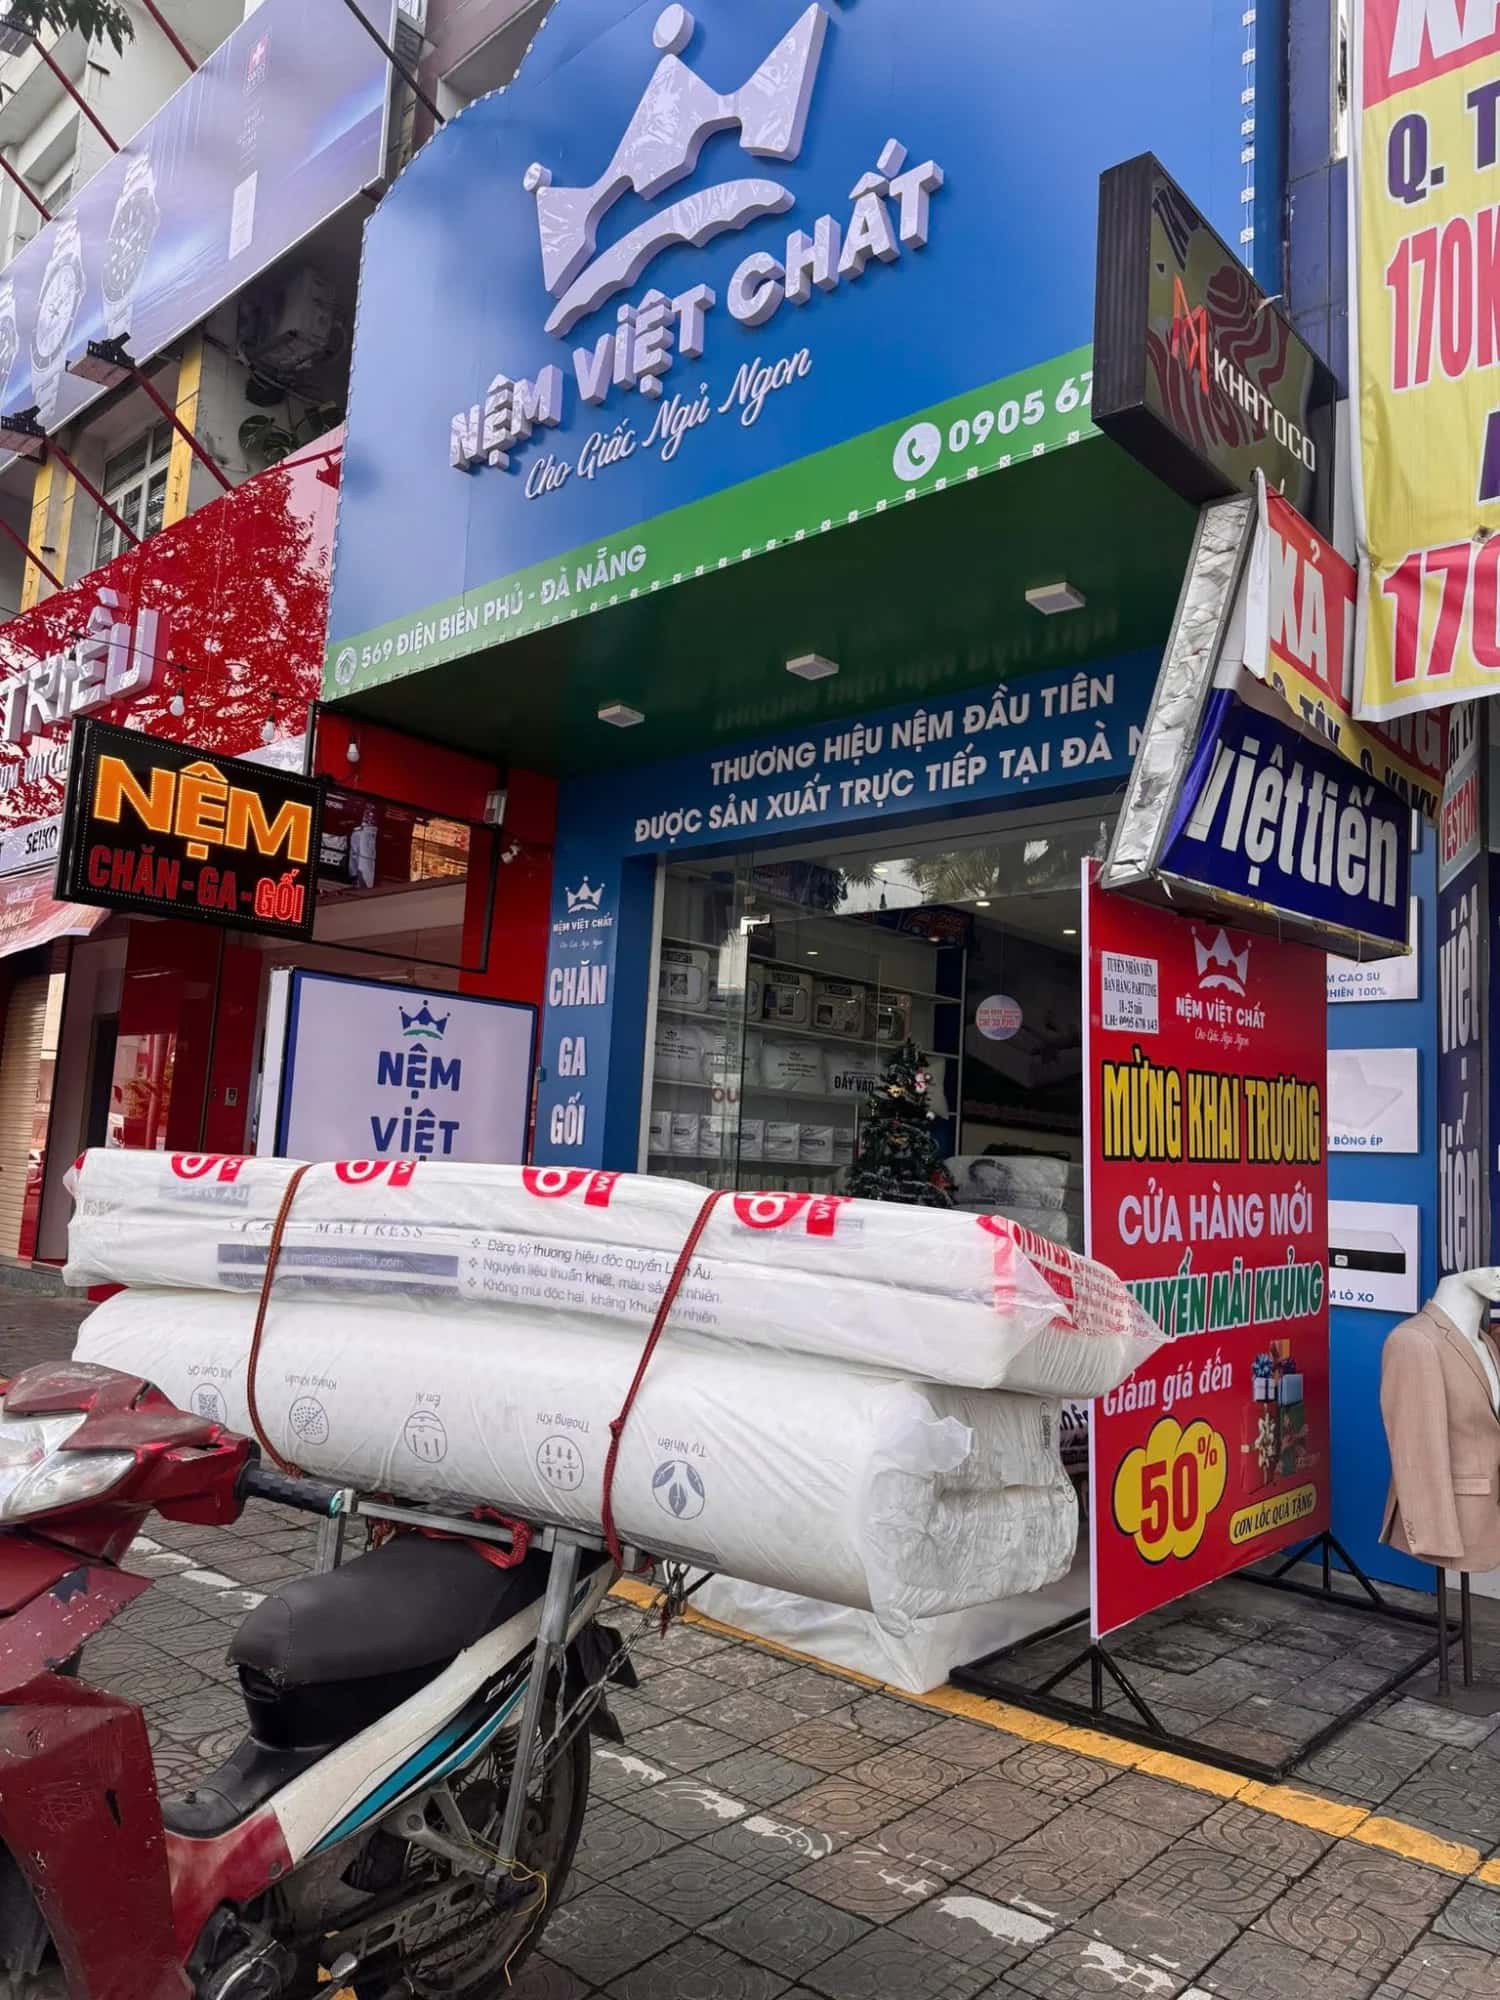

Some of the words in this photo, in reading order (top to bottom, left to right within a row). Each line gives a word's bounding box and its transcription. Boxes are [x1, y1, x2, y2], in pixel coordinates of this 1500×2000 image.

[450, 365, 563, 472] NỆM
[572, 284, 716, 405] VIỆT
[727, 137, 944, 327] CHẤT
[525, 456, 573, 499] Cho
[577, 416, 636, 482] Giấc
[642, 383, 710, 461] Ngủ
[718, 347, 812, 427] Ngon
[948, 391, 1044, 453] 0905
[1054, 372, 1093, 409] 67
[1214, 348, 1316, 473] KHATOCO
[360, 640, 393, 669] 569
[396, 620, 435, 658] ĐIỆN
[439, 605, 479, 642] BIÊN
[483, 581, 523, 633] PHỦ
[540, 570, 571, 606] ĐÀ
[575, 544, 648, 595] NẴNG
[1382, 534, 1500, 685] 170
[711, 741, 817, 786] THƯƠNG
[824, 723, 883, 765] HIỆU
[891, 708, 953, 753] NỆM
[962, 683, 1030, 736] ĐẦU
[1041, 672, 1115, 718] TIÊN
[0, 764, 19, 795] UM
[24, 745, 70, 785] WATCH
[635, 806, 701, 844] ĐƯỢC
[708, 795, 758, 828] SẢN
[767, 773, 831, 816] XUẤT
[839, 768, 914, 808] TRỰC
[925, 742, 987, 791] TIẾP
[999, 743, 1050, 784] TẠI
[1060, 721, 1113, 767] ĐÀ
[25, 825, 58, 854] SEIKO
[93, 754, 313, 864] NỆM
[89, 843, 181, 900] CHĂN
[199, 867, 238, 911] GA
[254, 869, 305, 923] GỐI
[572, 917, 589, 933] VIỆT
[549, 959, 607, 1007] CHĂN
[1176, 992, 1203, 1023] NỆM
[1206, 998, 1232, 1029] VIỆT
[1236, 1001, 1266, 1029] CHẤT
[1329, 986, 1354, 998] HIÊN
[1338, 973, 1363, 983] CAO
[377, 1043, 462, 1100] NỆM
[558, 1036, 587, 1077] GA
[370, 1106, 460, 1162] VIỆT
[550, 1091, 586, 1145] GỐI
[1103, 1044, 1181, 1160] MỪNG
[1186, 1070, 1241, 1162] KHAI
[1245, 1074, 1321, 1163] TRƯƠNG
[1118, 1177, 1183, 1245] CỬA
[1189, 1180, 1264, 1241] HÀNG
[1269, 1180, 1313, 1235] MỚI
[1210, 1257, 1252, 1330] MÃI
[1253, 1245, 1323, 1324] KHỦNG
[1162, 1360, 1193, 1411] giá
[1199, 1346, 1233, 1394] đến
[1140, 1433, 1218, 1545] 50%
[1234, 1516, 1252, 1539] CƠN
[1272, 1500, 1291, 1524] QUÀ
[1291, 1491, 1313, 1520] TẶNG
